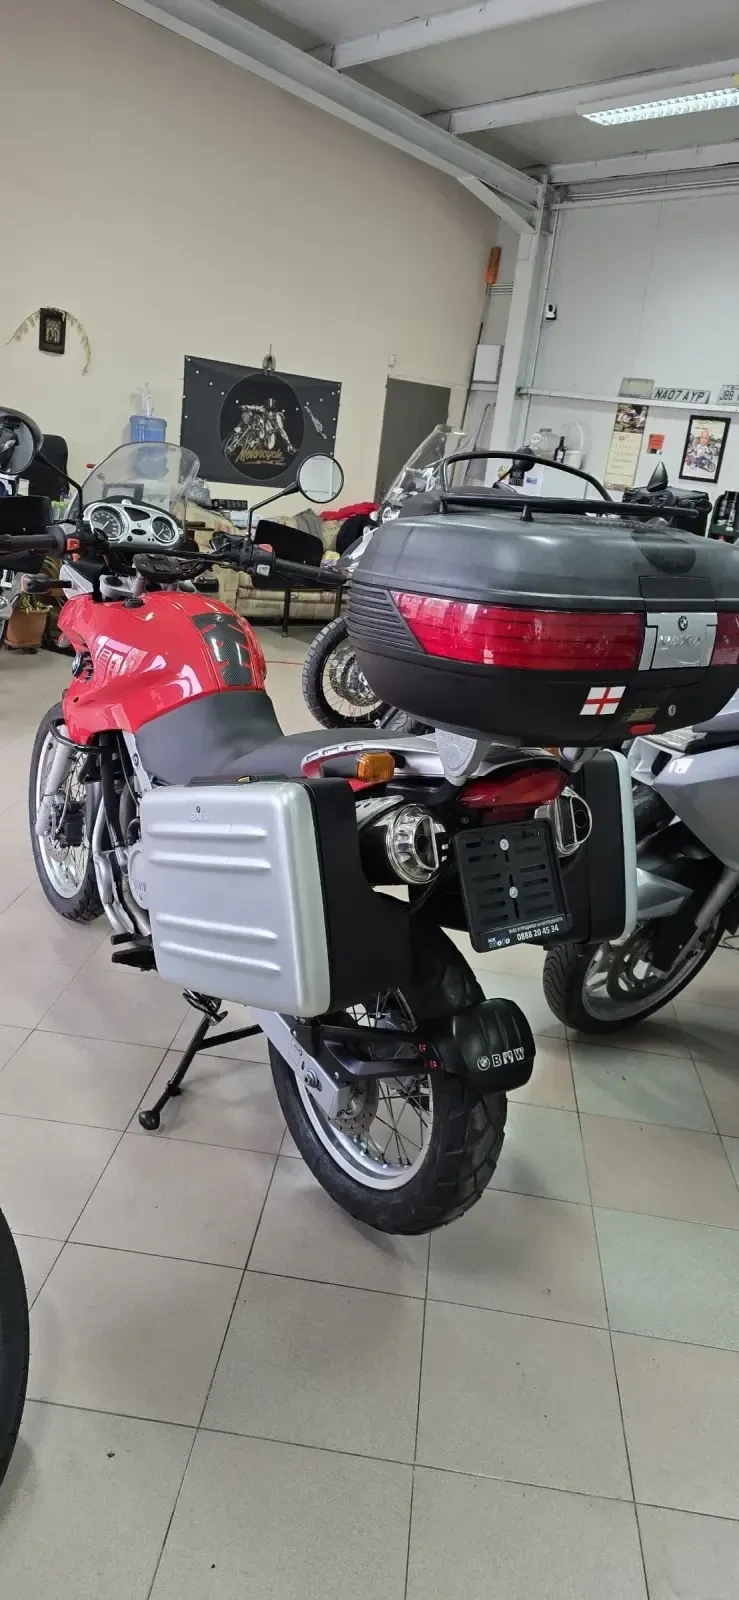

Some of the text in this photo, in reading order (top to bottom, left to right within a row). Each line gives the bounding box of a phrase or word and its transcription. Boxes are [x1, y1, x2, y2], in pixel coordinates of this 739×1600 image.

[654, 390, 705, 402] NA07 AYP
[235, 445, 284, 462] Motorcycle
[188, 812, 208, 822] BMW
[516, 924, 560, 941] 0888 20 45 34
[492, 1047, 524, 1067] BMW
